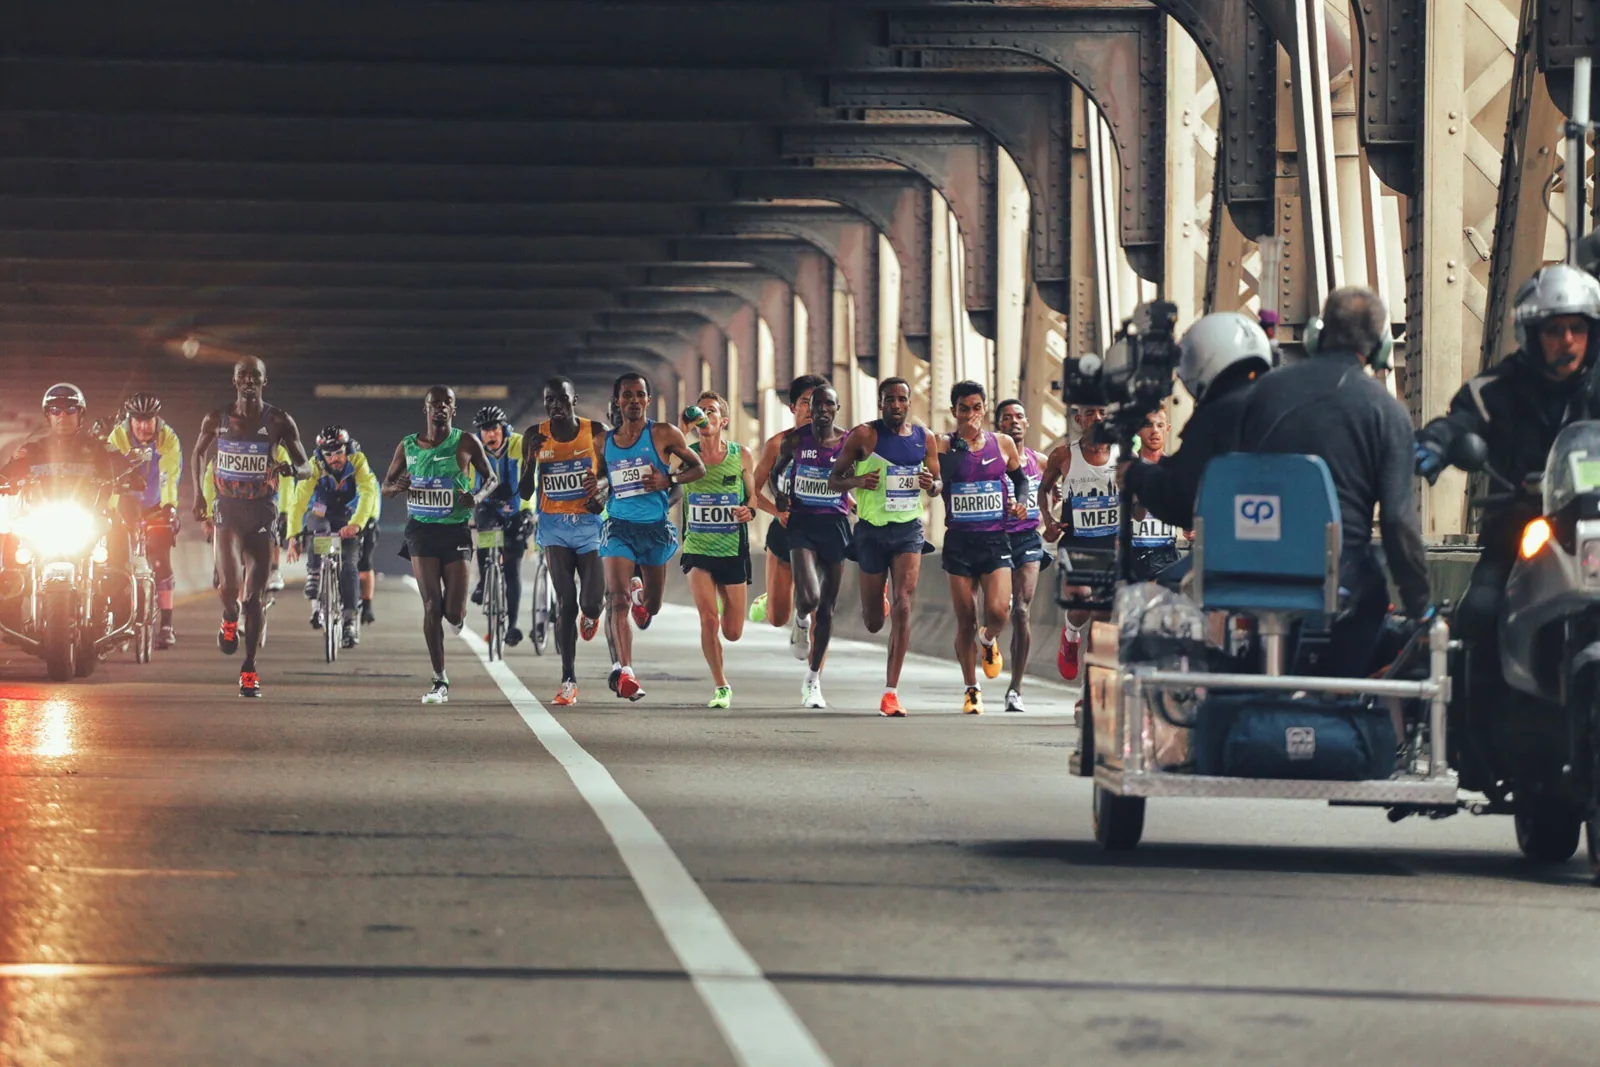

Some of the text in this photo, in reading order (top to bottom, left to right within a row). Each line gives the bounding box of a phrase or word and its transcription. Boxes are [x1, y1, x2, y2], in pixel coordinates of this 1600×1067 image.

[219, 452, 265, 471] KIPSANG
[801, 449, 817, 459] NRC
[543, 472, 588, 491] BIWOT
[622, 469, 640, 482] 259
[899, 477, 913, 489] 249
[796, 478, 841, 496] KAMWO
[407, 489, 452, 507] CHELIMO
[953, 494, 1002, 512] BARRIOS
[692, 507, 735, 523] LEON
[1081, 509, 1118, 527] MEB
